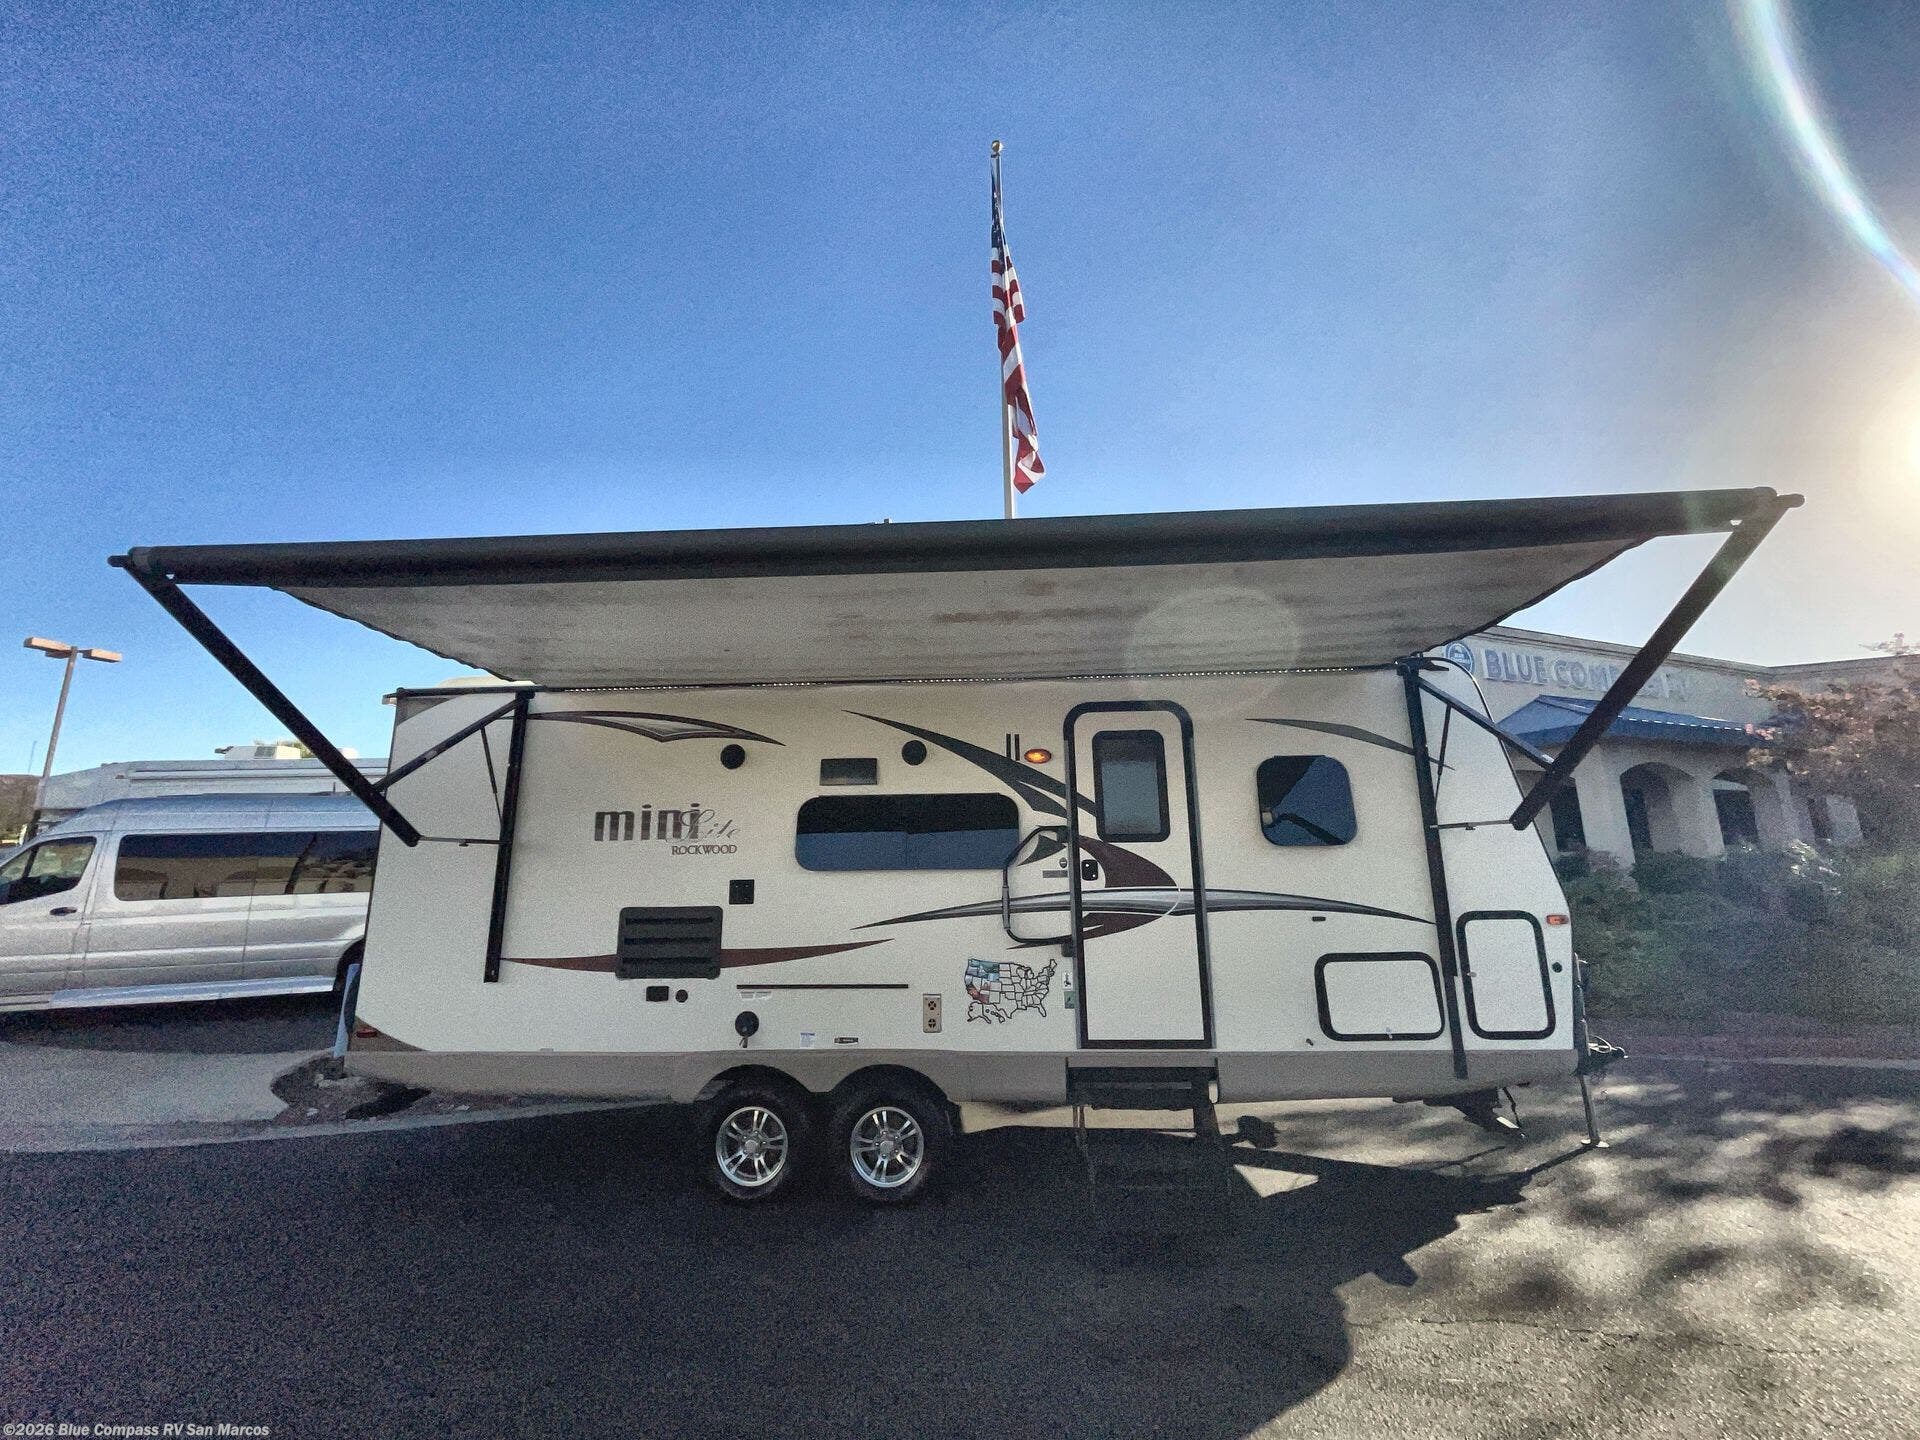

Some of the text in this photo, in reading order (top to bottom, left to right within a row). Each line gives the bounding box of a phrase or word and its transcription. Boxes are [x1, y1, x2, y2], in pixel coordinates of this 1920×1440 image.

[1484, 648, 1548, 685] BLUE
[594, 802, 701, 842] mini
[671, 844, 738, 856] ROCKWOOD
